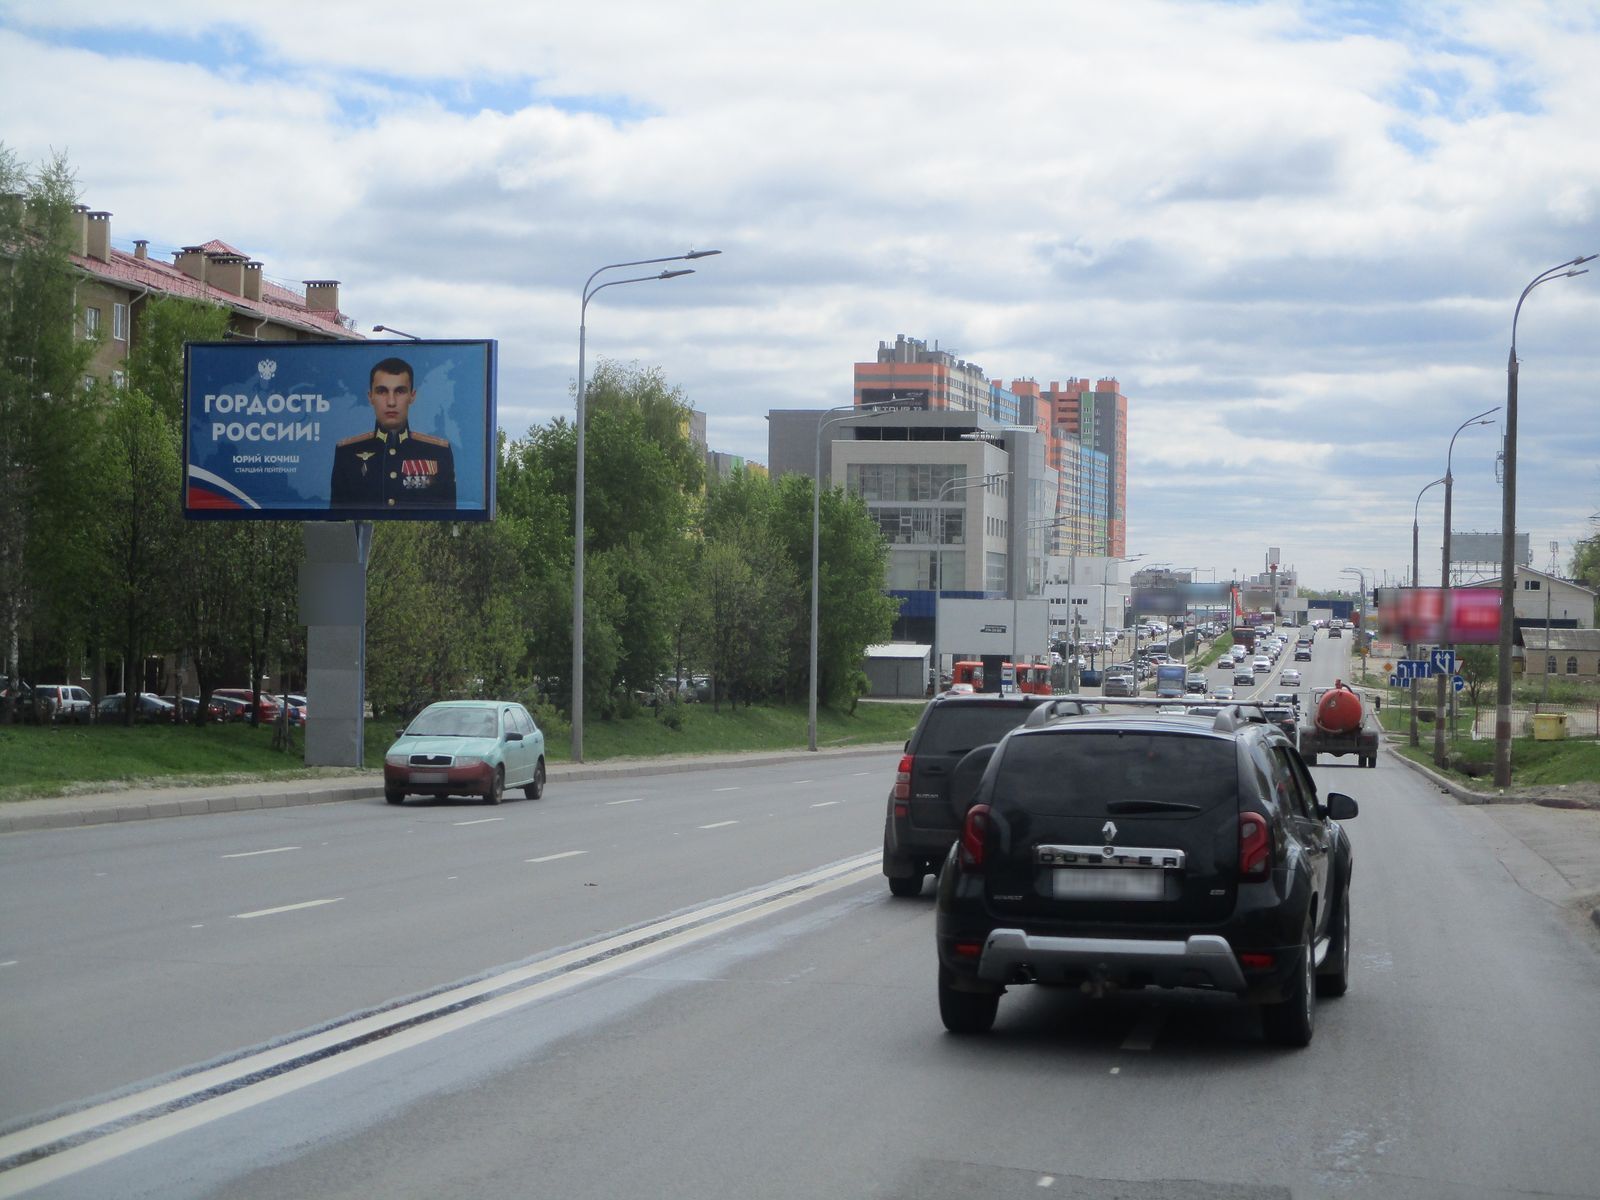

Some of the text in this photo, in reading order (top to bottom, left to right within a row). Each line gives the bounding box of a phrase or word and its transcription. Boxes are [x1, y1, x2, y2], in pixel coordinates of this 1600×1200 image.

[204, 394, 330, 415] ГОРДОСТЬ
[212, 422, 320, 441] РОССИИ!
[232, 453, 300, 463] ЮРИЙ КОЧИШ
[1041, 853, 1178, 867] DUSTER
